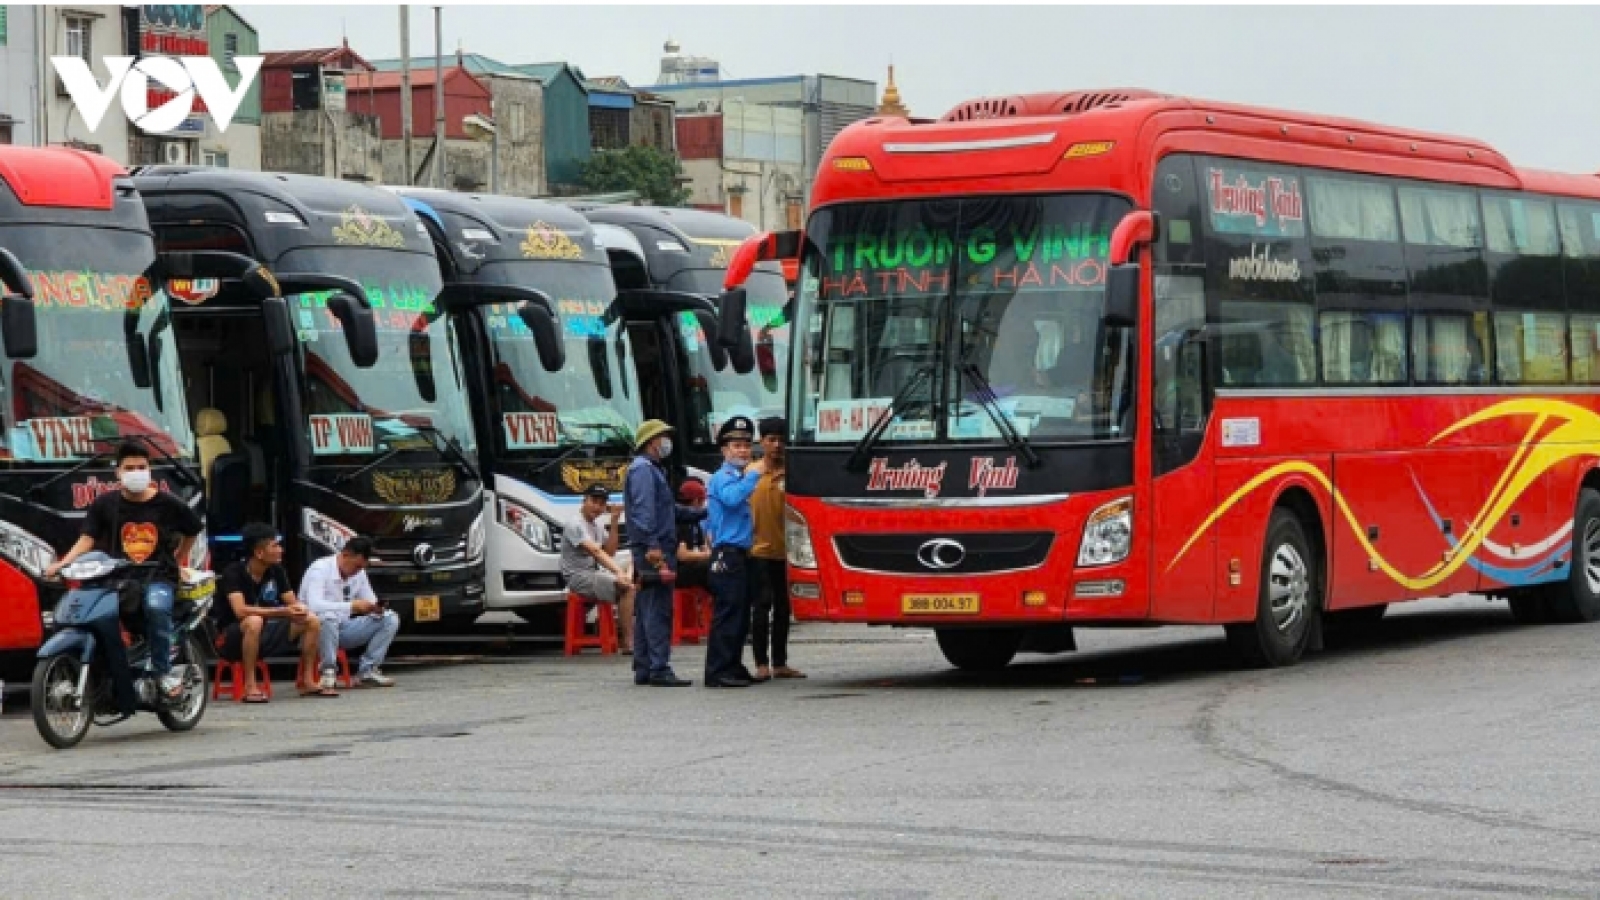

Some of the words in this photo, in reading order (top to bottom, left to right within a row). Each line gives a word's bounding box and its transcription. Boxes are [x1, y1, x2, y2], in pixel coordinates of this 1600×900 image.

[30, 417, 94, 458] VINH
[336, 417, 373, 448] VINH
[505, 414, 557, 445] VINH
